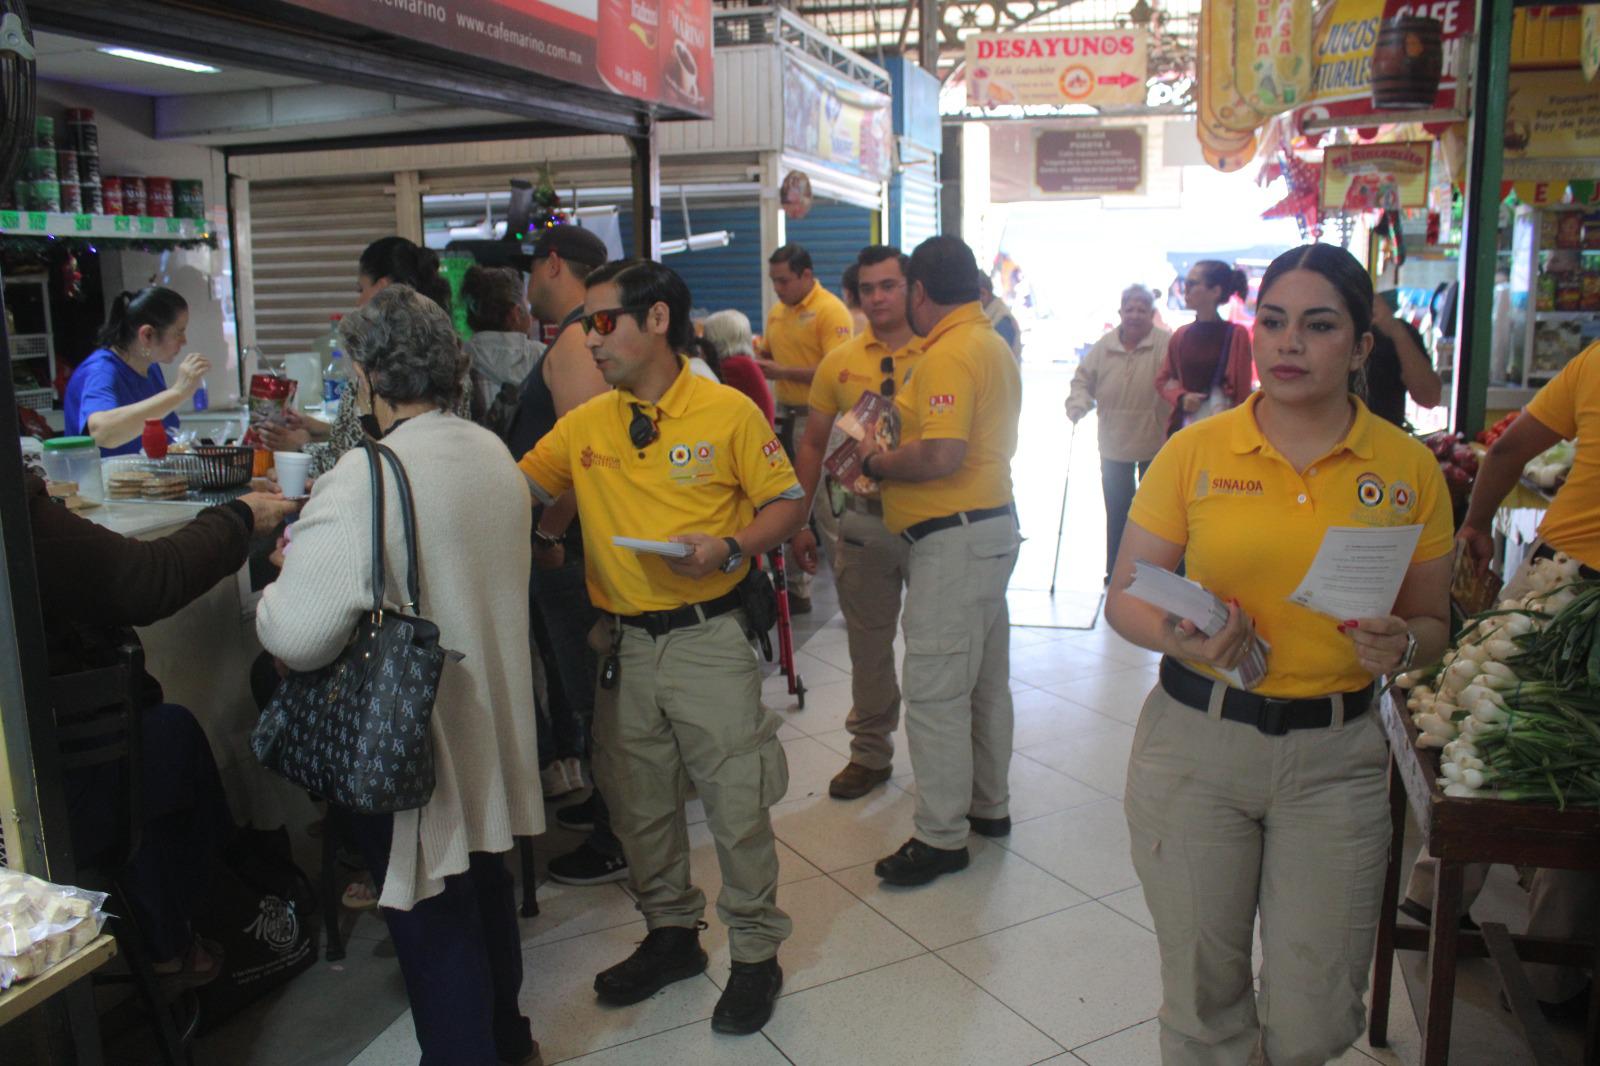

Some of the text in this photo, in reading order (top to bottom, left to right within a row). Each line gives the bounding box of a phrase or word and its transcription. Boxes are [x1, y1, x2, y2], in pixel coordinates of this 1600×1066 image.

[456, 11, 583, 64] www.cafemarino.com.mx
[977, 36, 1135, 59] DESAYUNOS
[1318, 17, 1380, 55] JUGOS
[1312, 57, 1378, 90] ATURALES
[1211, 478, 1264, 491] SINALOA
